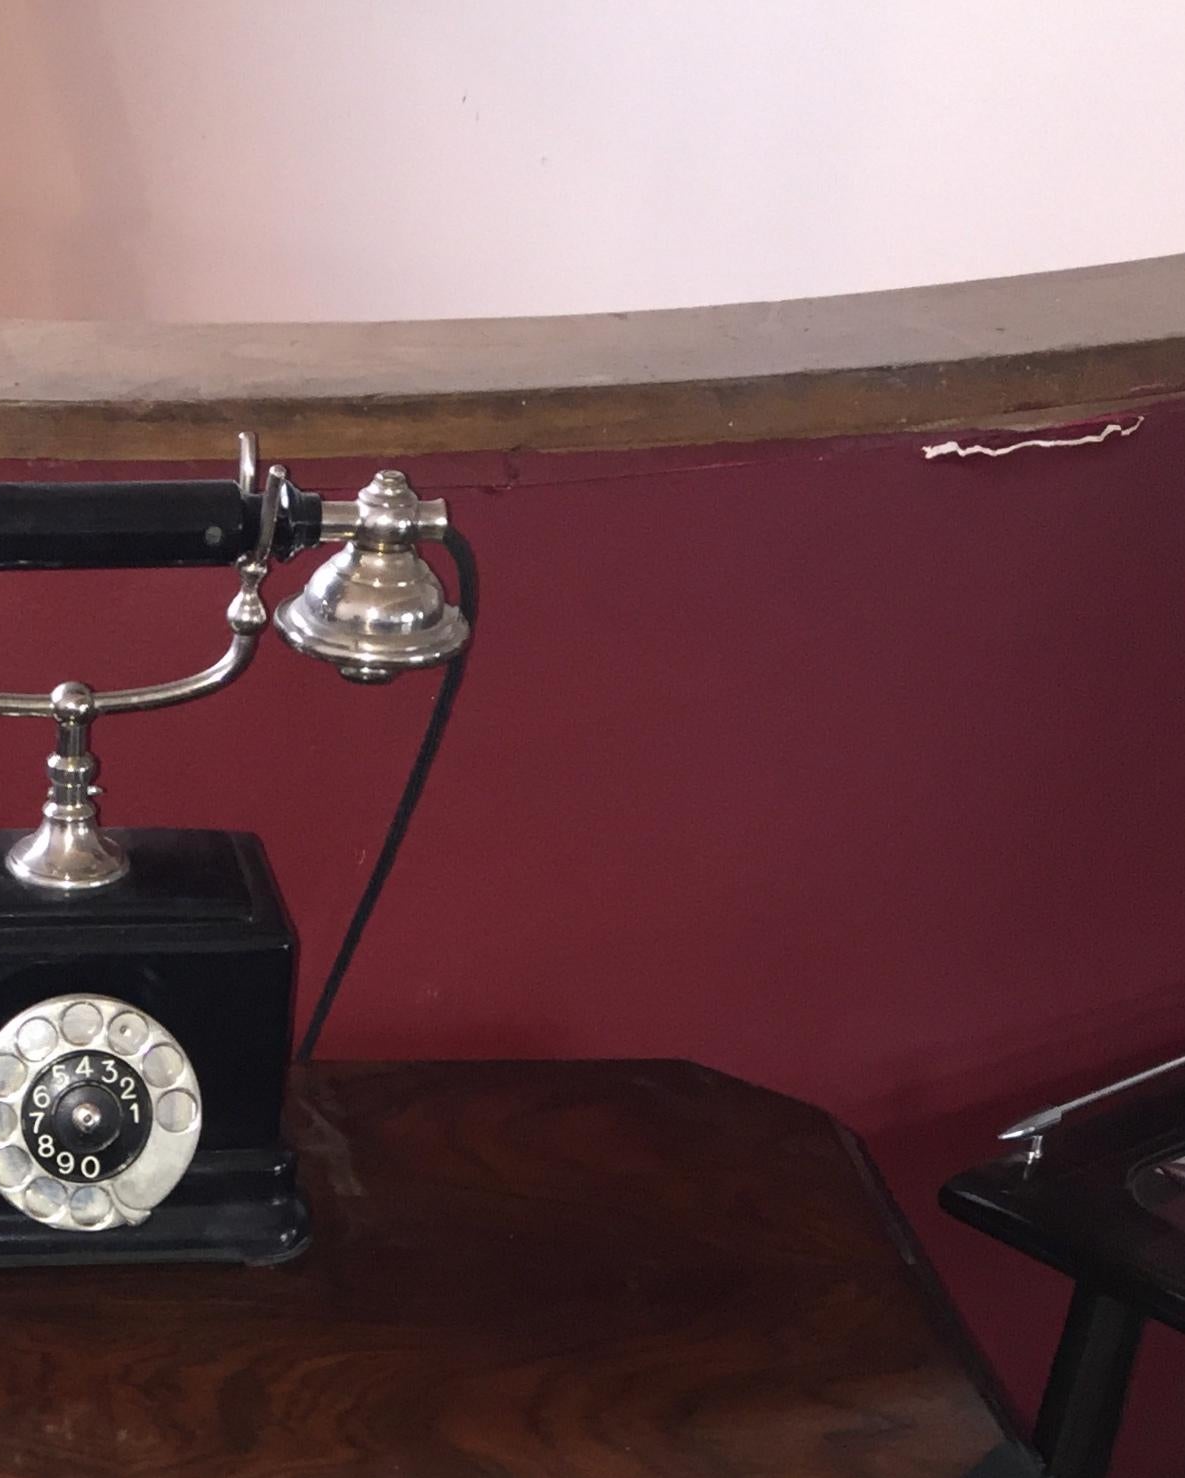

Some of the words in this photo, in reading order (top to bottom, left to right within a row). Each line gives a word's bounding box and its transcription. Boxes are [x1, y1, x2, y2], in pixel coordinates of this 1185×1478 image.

[52, 1065, 69, 1086] 5
[75, 1056, 93, 1077] 4
[102, 1060, 118, 1082] 3
[33, 1086, 50, 1107] 6
[120, 1078, 136, 1099] 2
[29, 1112, 45, 1133] 7
[130, 1103, 139, 1123] 1
[38, 1135, 54, 1157] 8
[57, 1152, 74, 1173] 9
[81, 1156, 99, 1177] 0
